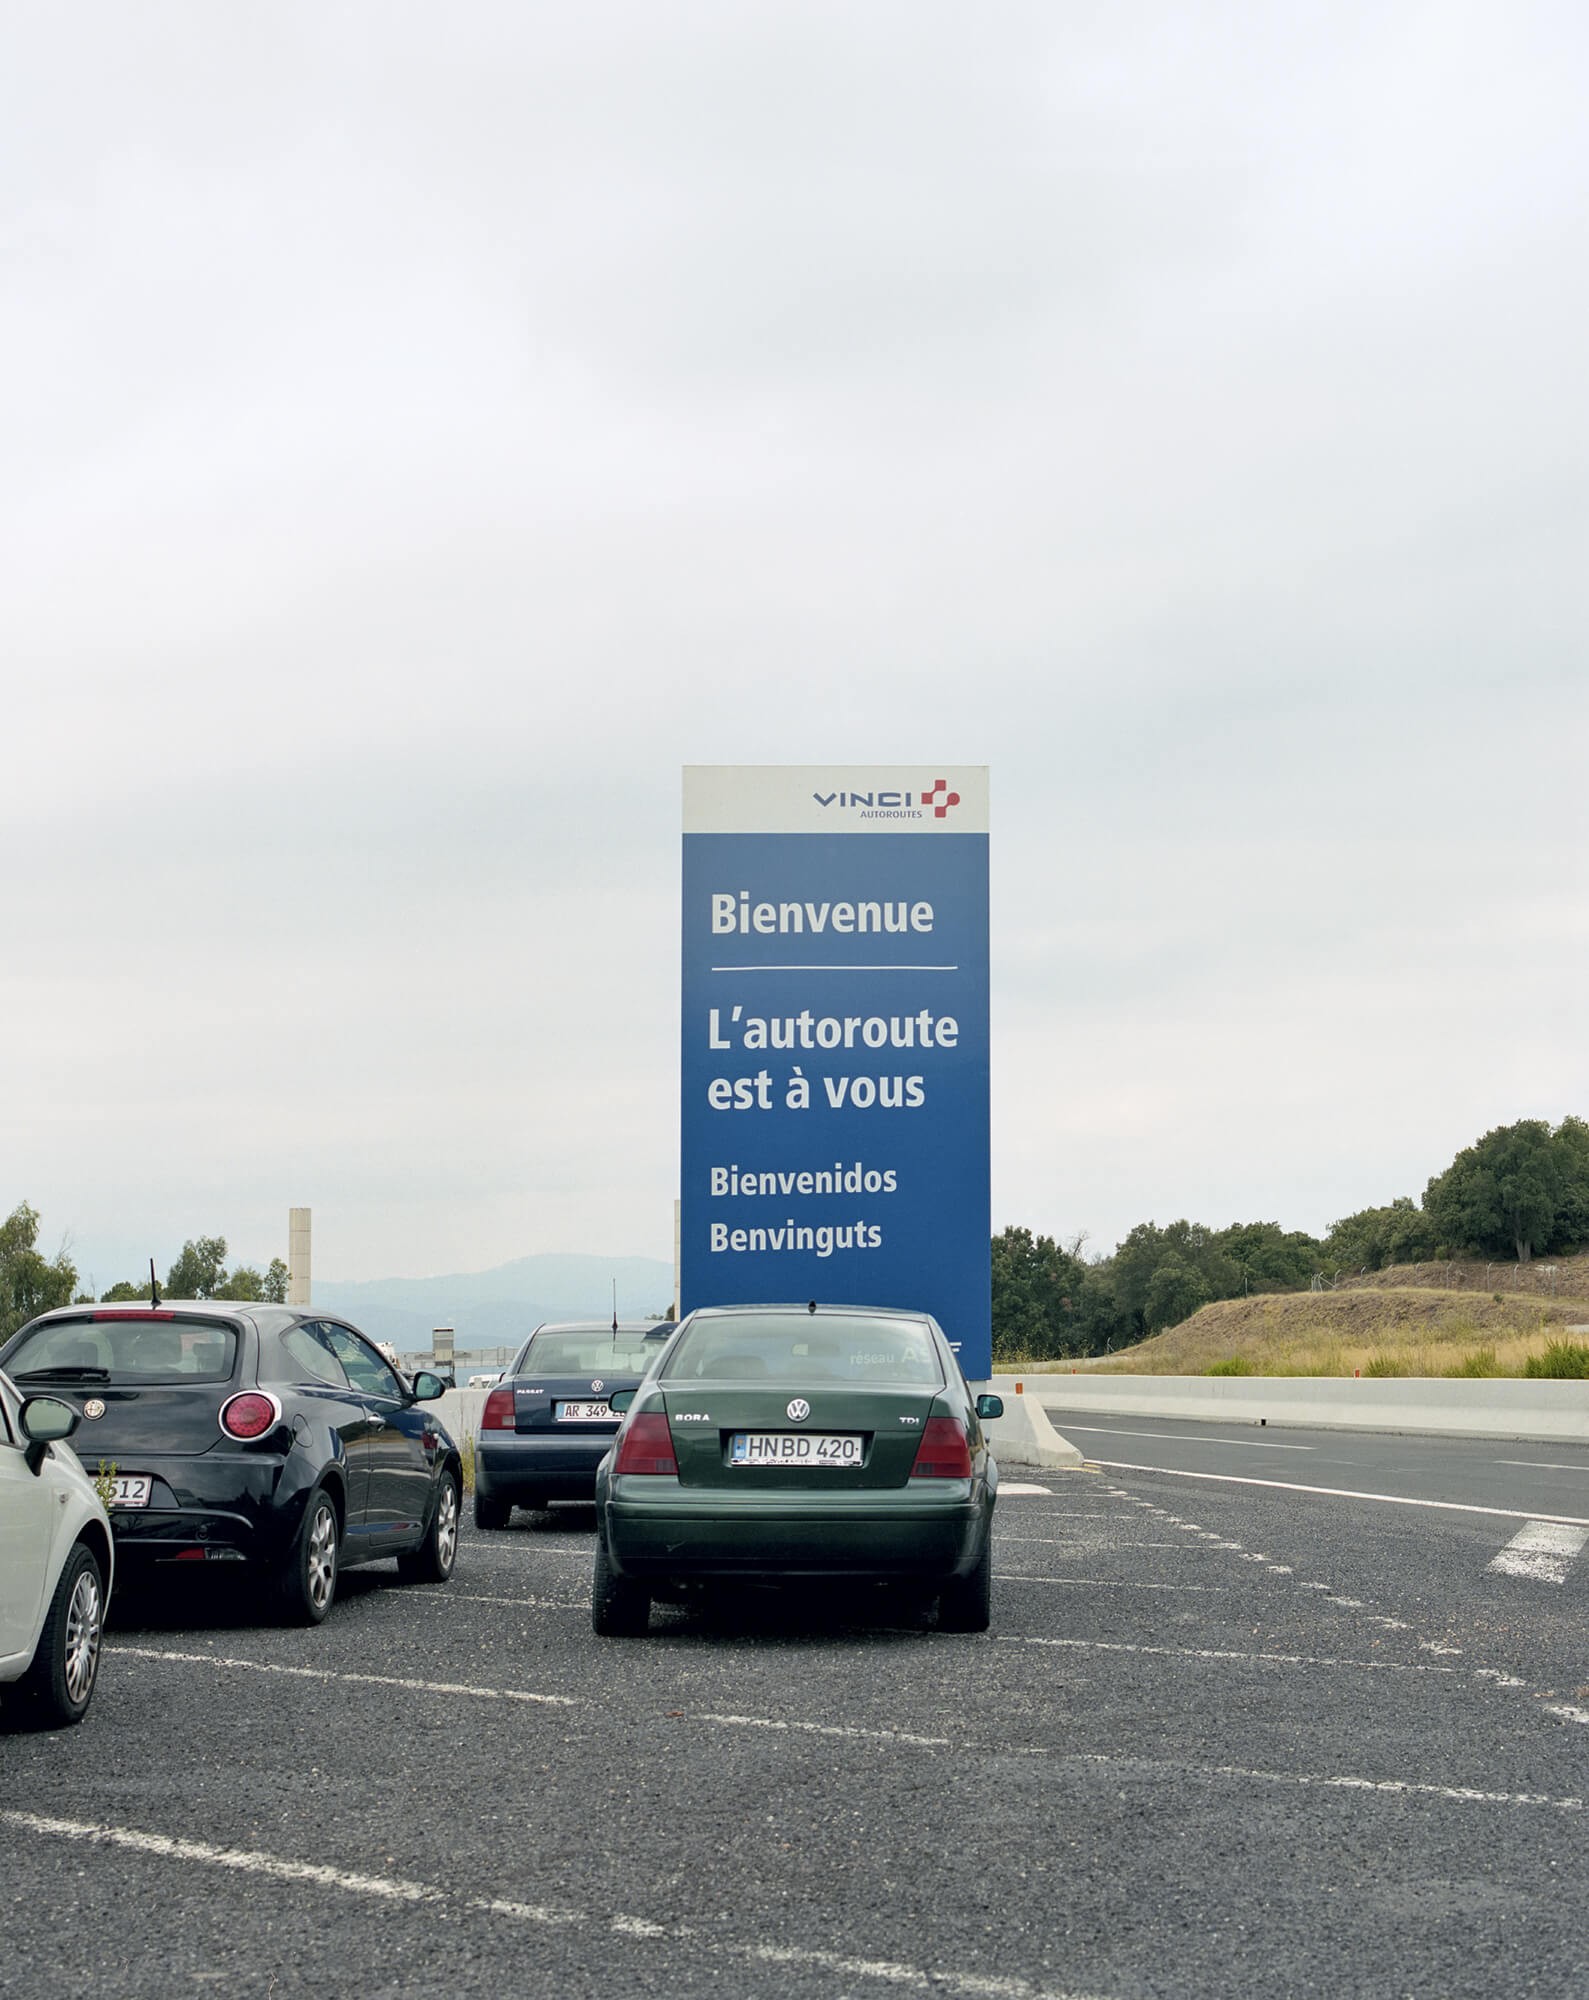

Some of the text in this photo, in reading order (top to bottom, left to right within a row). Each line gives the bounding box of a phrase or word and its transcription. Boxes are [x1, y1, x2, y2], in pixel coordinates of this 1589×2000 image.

[813, 792, 912, 807] VINCI
[859, 810, 923, 819] AUTOROUTES
[711, 890, 934, 934] Bienvenue
[709, 1005, 959, 1049] L’autoroute
[708, 1066, 925, 1110] est à vous
[711, 1162, 897, 1196] Bienvenidos
[711, 1219, 882, 1258] Benvinguts
[850, 1351, 895, 1364] réseau
[565, 1404, 580, 1417] AR
[585, 1404, 608, 1417] 349
[674, 1413, 710, 1422] BORA
[899, 1415, 920, 1424] TDI
[817, 1439, 855, 1458] 420
